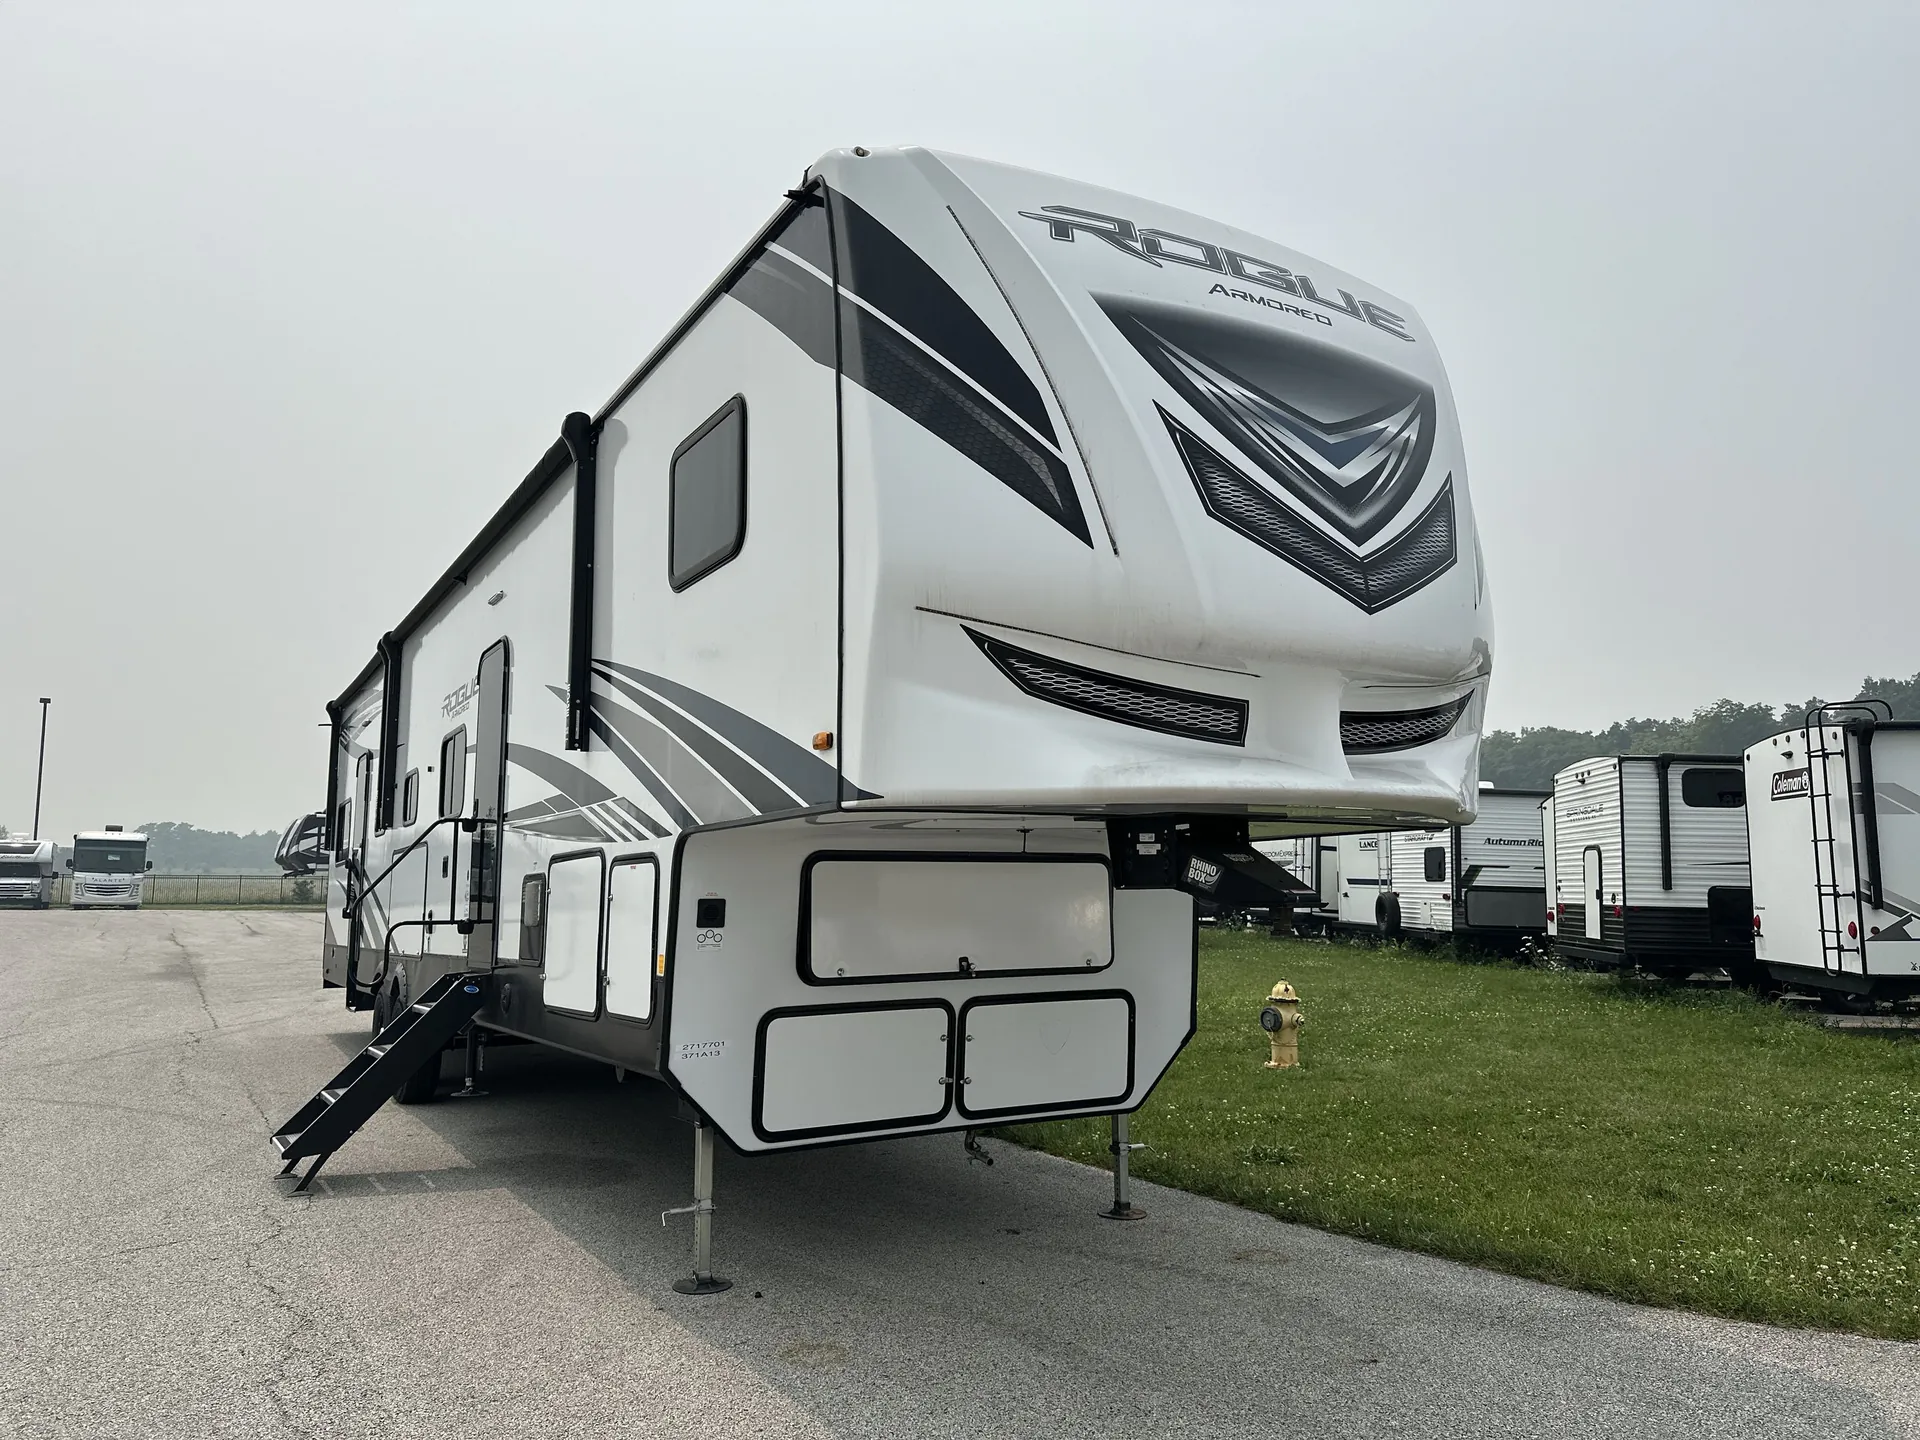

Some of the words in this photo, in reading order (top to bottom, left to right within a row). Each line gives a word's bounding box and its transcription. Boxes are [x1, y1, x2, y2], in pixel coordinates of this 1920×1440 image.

[1018, 205, 1416, 343] ROGUE
[1208, 283, 1333, 327] ARMORED
[441, 674, 479, 719] ROGUE
[1772, 773, 1802, 795] Coleman
[1359, 840, 1378, 849] LANCE
[1188, 867, 1207, 884] BOX
[1190, 857, 1217, 876] RHINO
[681, 1050, 721, 1060] 371A13
[682, 1040, 725, 1051] 2717701
